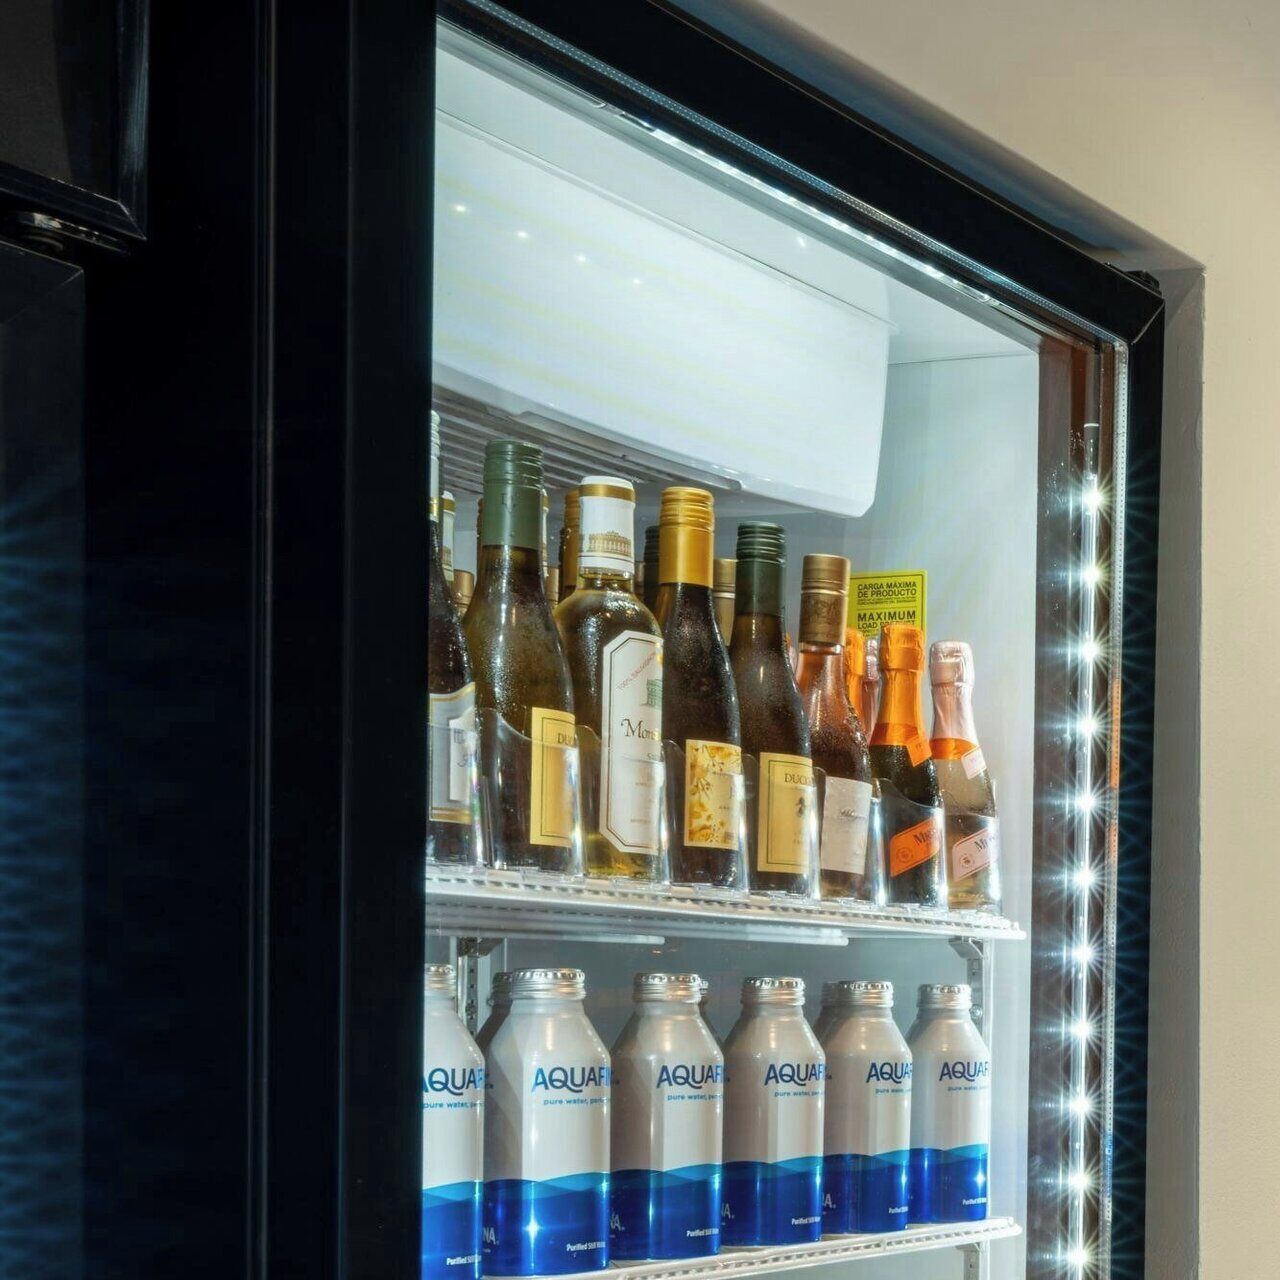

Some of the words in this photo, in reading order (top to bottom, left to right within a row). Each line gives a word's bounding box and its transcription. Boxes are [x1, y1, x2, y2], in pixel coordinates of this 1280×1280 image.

[857, 582, 884, 591] CARGA
[857, 590, 868, 598] DE
[870, 588, 917, 597] PRODUCTO
[857, 611, 916, 622] MAXIMUM
[656, 1064, 725, 1090] AQUAF
[764, 1063, 826, 1087] AQUAF
[423, 1067, 485, 1096] QUAF
[424, 1101, 444, 1109] pure
[543, 1098, 563, 1106] pure
[566, 1242, 588, 1252] Purified
[446, 1255, 467, 1266] Purified
